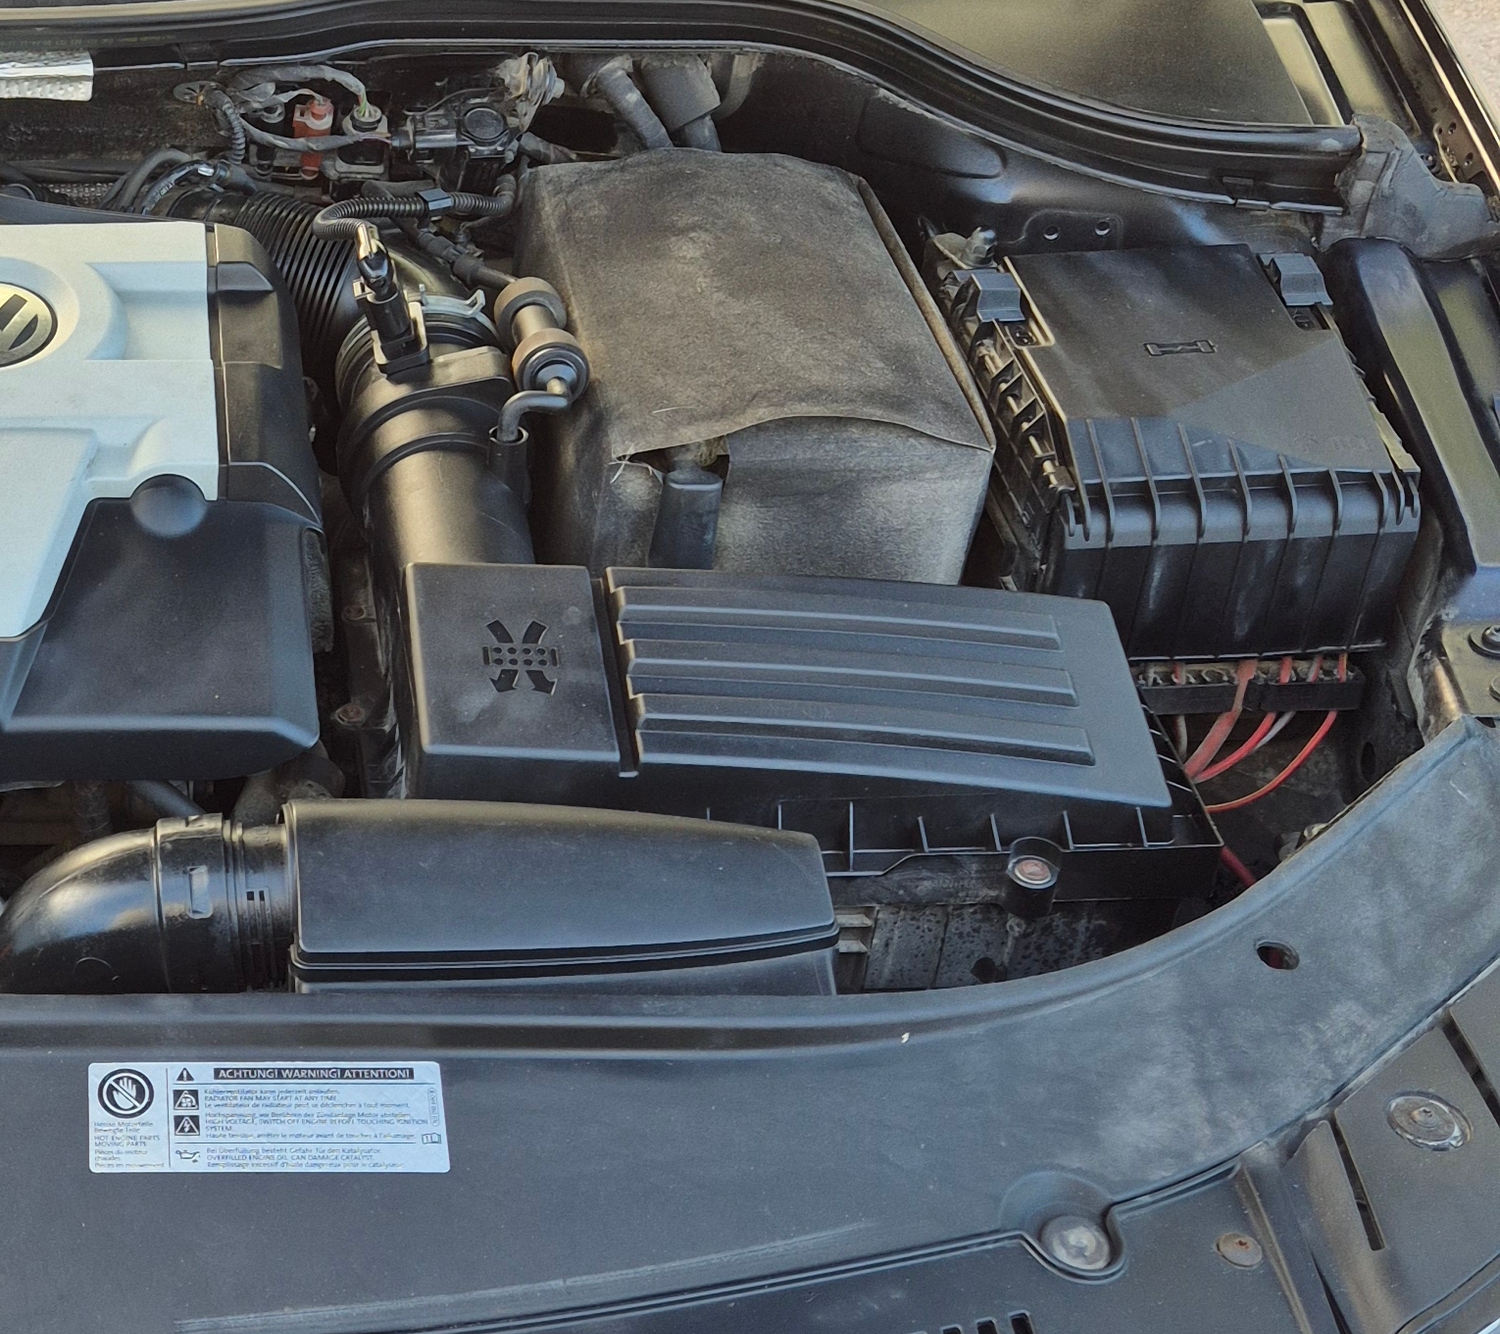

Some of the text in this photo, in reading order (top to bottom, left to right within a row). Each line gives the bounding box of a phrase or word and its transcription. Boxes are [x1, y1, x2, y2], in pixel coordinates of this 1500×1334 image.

[218, 1069, 409, 1078] ACHTUNG! WARNING! ATTENTION!
